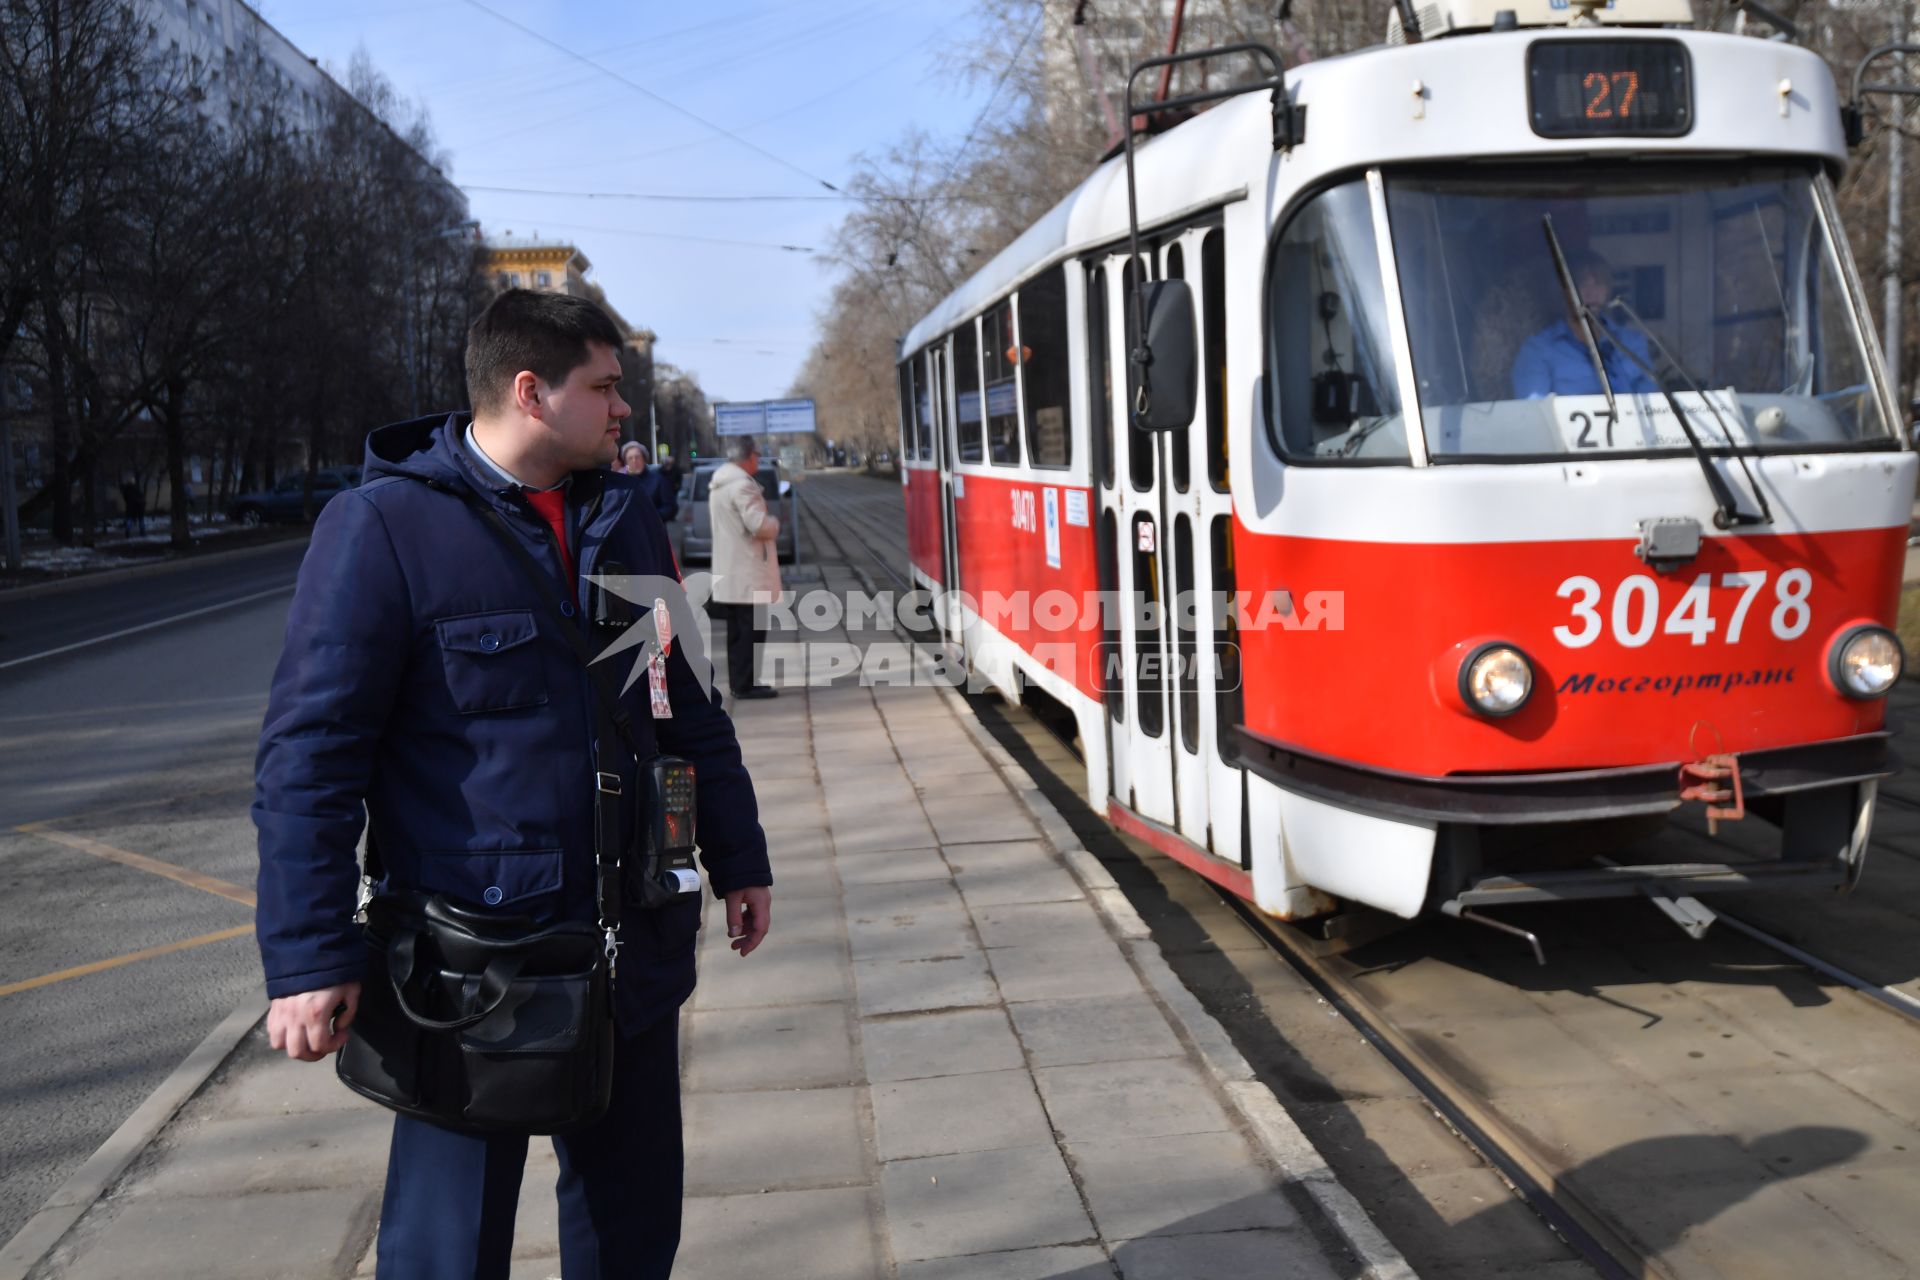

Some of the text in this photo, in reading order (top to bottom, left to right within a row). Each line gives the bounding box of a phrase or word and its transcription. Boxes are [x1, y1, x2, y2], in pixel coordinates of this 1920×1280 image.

[1583, 71, 1638, 119] 27
[1569, 409, 1614, 449] 27
[1010, 488, 1036, 534] 30478
[1553, 567, 1813, 649] 30478
[1557, 667, 1797, 696] Мосгортранс
